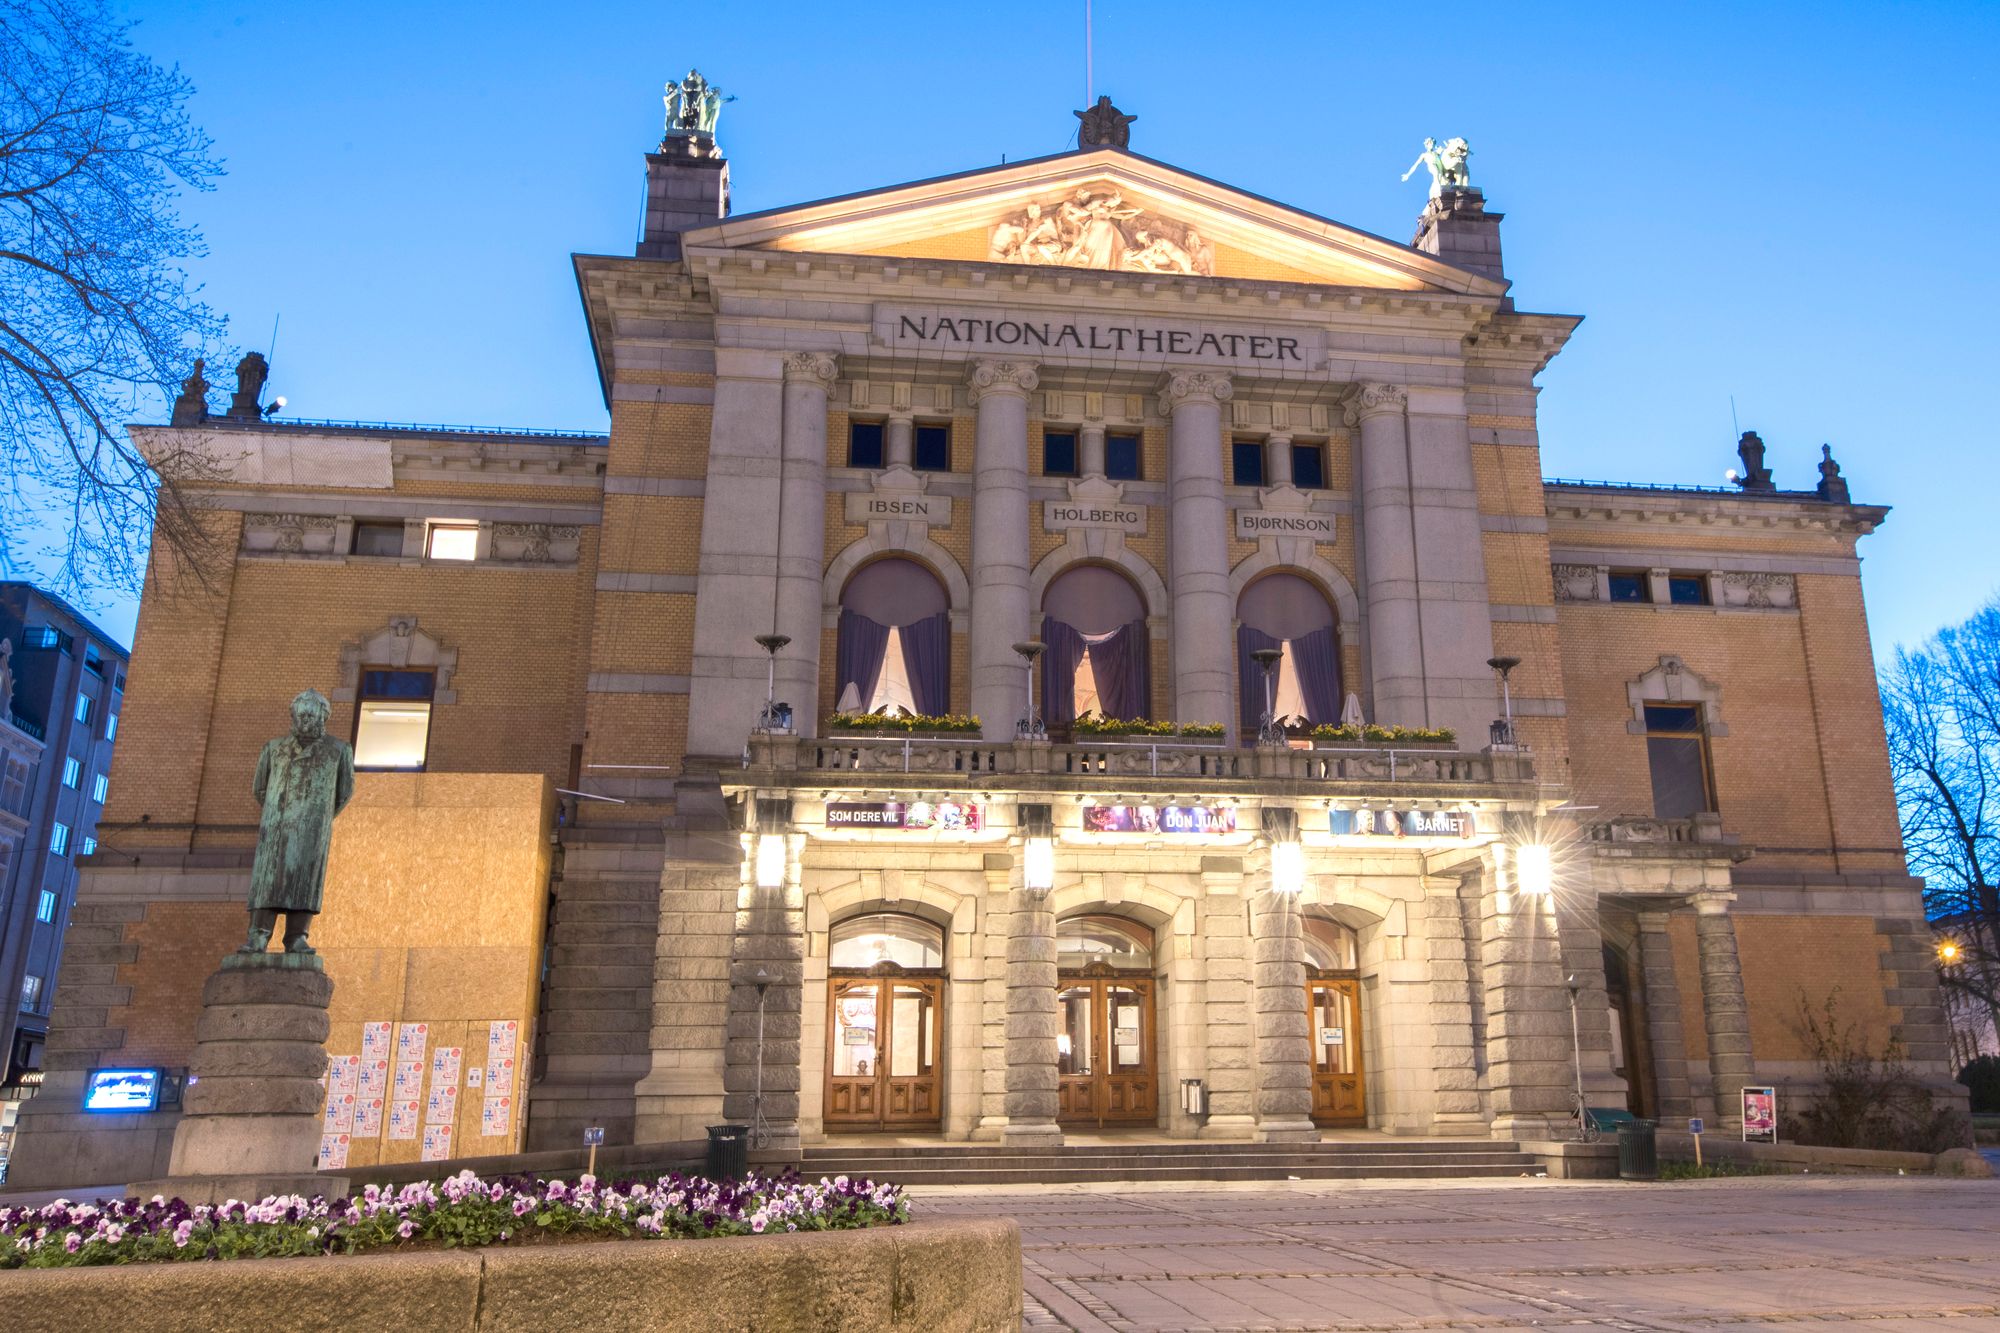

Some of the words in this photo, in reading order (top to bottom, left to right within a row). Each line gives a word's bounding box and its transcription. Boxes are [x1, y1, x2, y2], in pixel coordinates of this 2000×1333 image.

[899, 315, 1302, 361] NATIONALTHEATER
[869, 500, 928, 515] IBSEN
[1054, 508, 1138, 523] HOLBERG
[1243, 516, 1330, 532] BJØRNSON
[829, 810, 852, 822] SOM
[853, 810, 881, 823] DERE
[882, 811, 898, 823] VIL
[1166, 815, 1193, 828] DON
[1195, 815, 1228, 828] JUAN
[1416, 818, 1465, 832] BARNET
